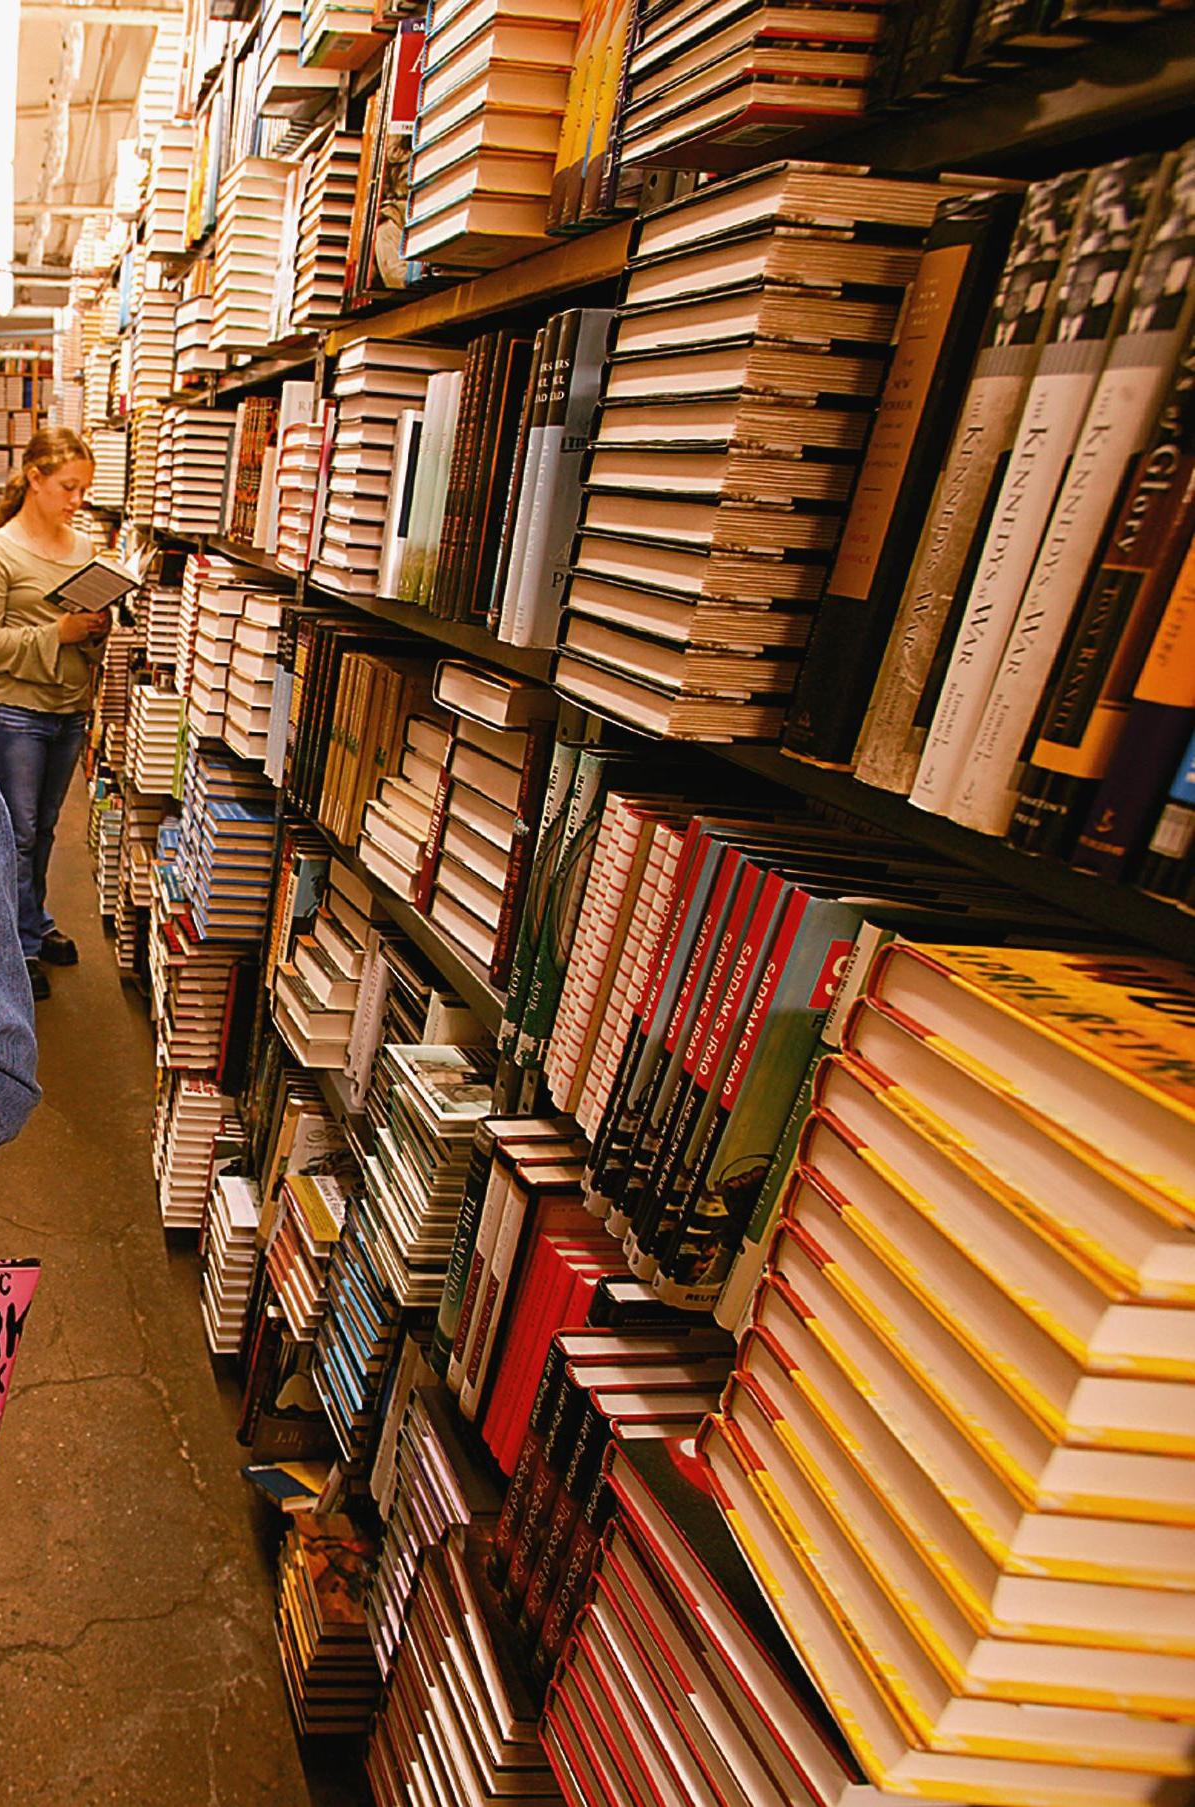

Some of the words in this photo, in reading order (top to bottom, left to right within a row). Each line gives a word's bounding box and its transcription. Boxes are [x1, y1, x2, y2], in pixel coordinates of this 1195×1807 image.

[927, 425, 984, 571] KENNEDYS
[986, 427, 1047, 582] KENNEDYS
[1038, 424, 1111, 587] KENNEDYS
[1117, 445, 1181, 552] Glory
[902, 591, 933, 650] WAR
[958, 604, 993, 665] WAR
[1006, 611, 1044, 674] WAR
[700, 933, 733, 1016] SADDAM'S
[715, 943, 752, 1031] SADDAM'S
[667, 1000, 682, 1039] IRAQ
[739, 962, 776, 1052] SADDAM'S
[685, 1020, 705, 1061] IRAQ
[699, 1034, 720, 1076] IRAQ
[723, 1053, 743, 1095] IRAQ
[462, 1196, 478, 1233] THE
[448, 1236, 467, 1302] SAPPHO
